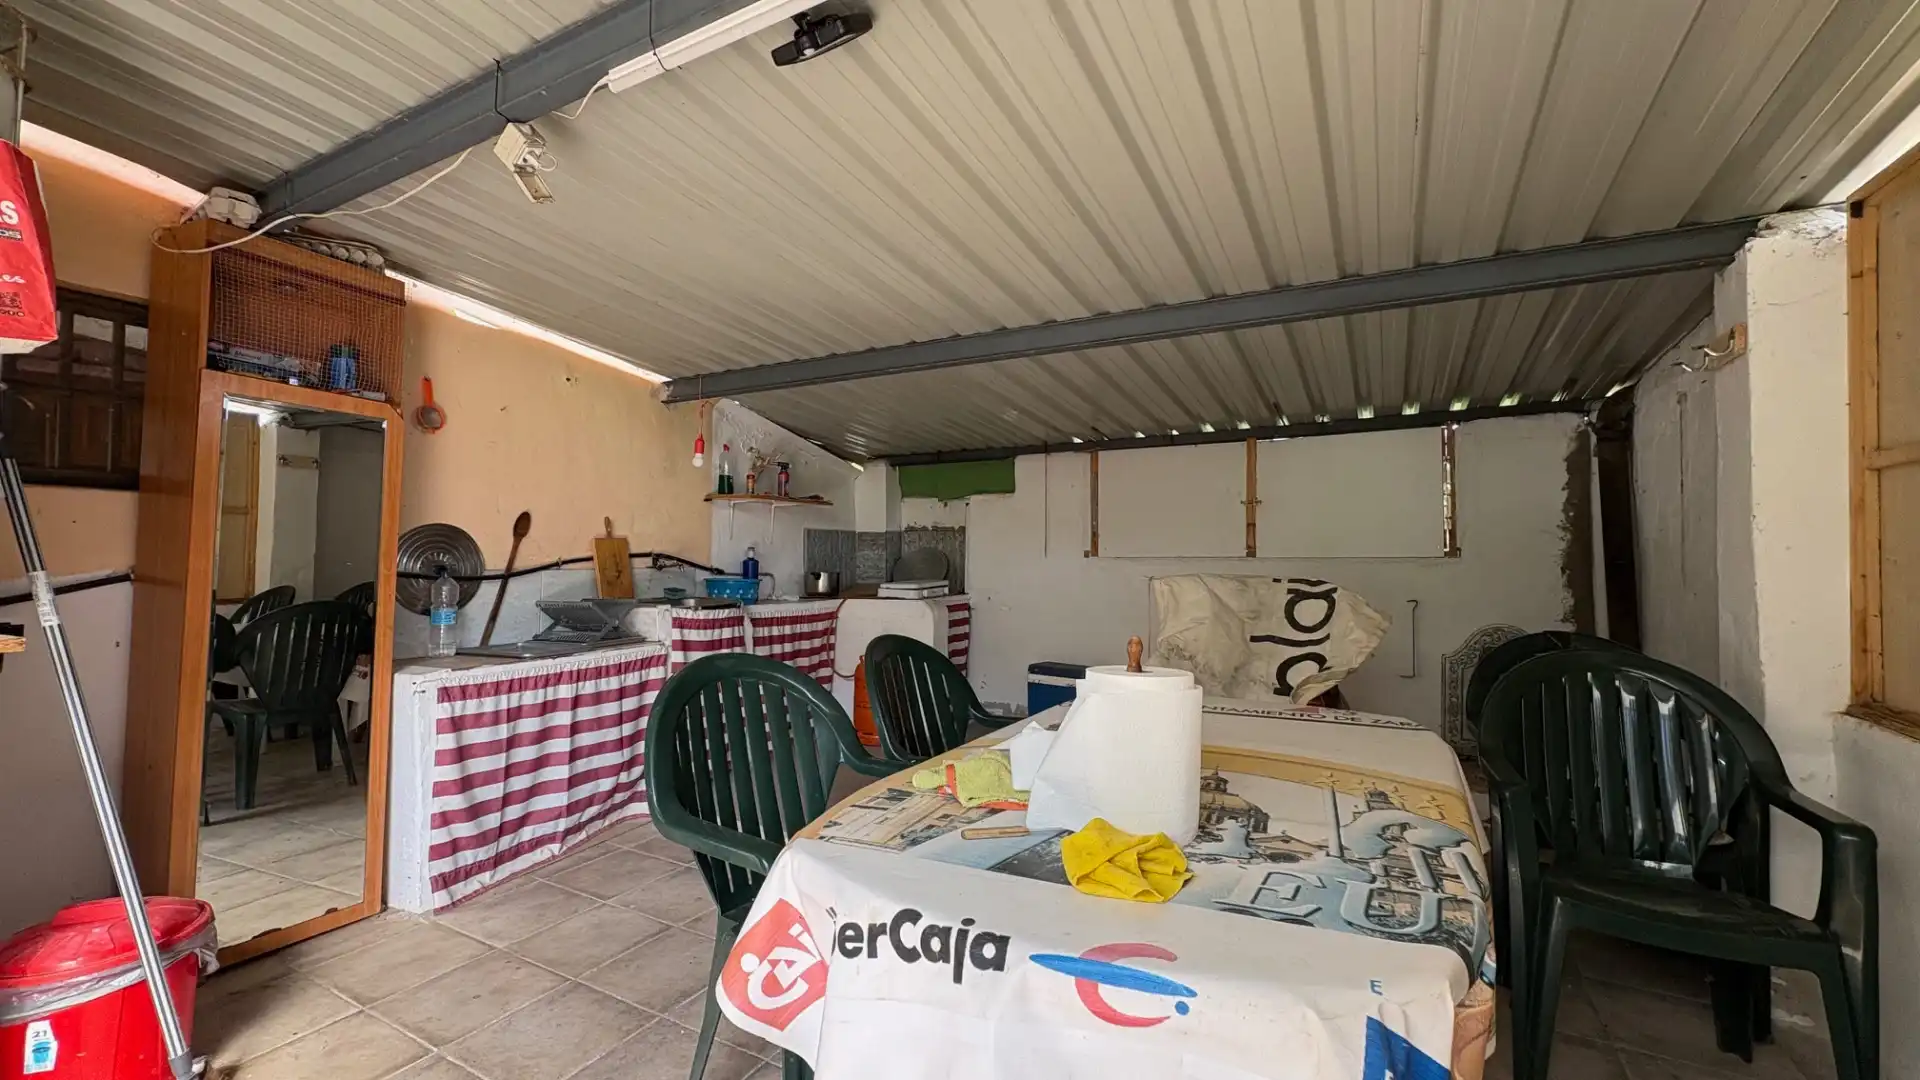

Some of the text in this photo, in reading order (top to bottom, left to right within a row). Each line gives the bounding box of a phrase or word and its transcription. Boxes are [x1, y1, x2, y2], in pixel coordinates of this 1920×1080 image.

[0, 200, 19, 225] S
[1202, 704, 1327, 719] NTAMIENTO
[826, 905, 1011, 985] erCaja
